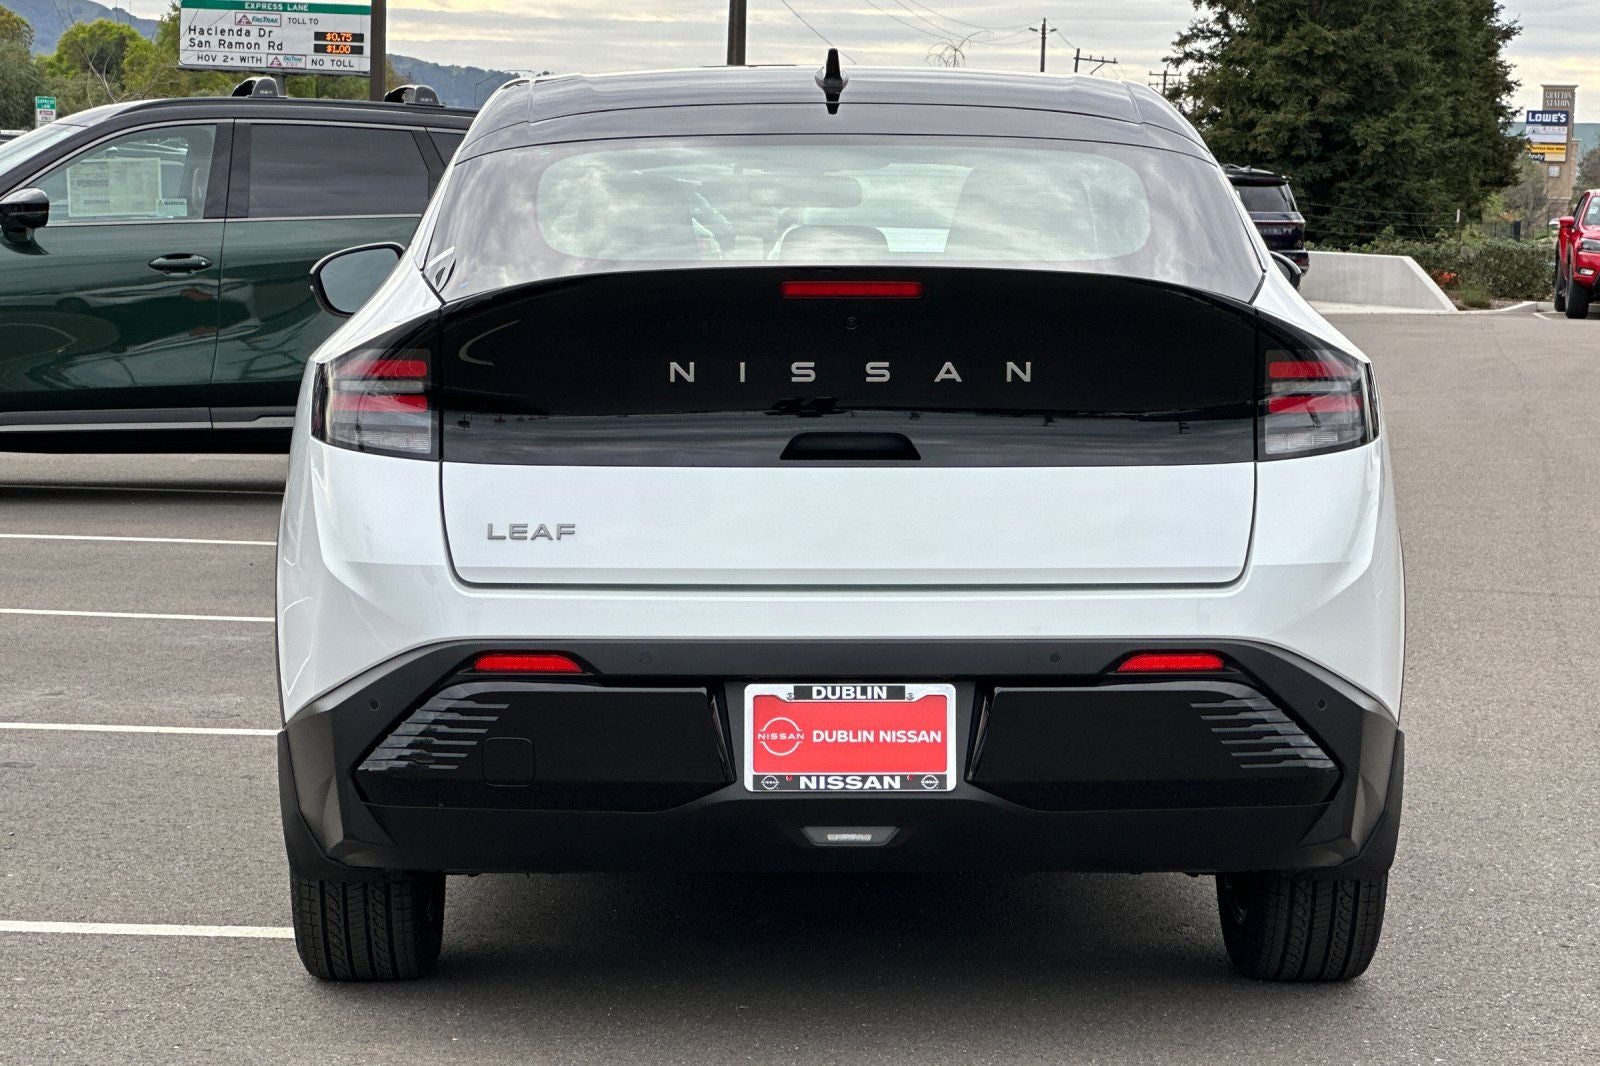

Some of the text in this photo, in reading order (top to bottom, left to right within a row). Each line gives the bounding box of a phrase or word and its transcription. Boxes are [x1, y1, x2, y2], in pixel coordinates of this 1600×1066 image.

[245, 2, 283, 10] EXPRESS
[189, 26, 273, 38] Hacienda Dr
[326, 32, 352, 42] $0.75
[189, 38, 283, 51] San Ramon Rd
[326, 45, 351, 54] $1.00
[197, 54, 217, 62] HOV
[240, 56, 262, 64] WITH
[311, 59, 324, 67] NO
[330, 59, 354, 68] TOLL
[1528, 112, 1567, 123] LOWE'S
[669, 361, 1032, 383] NISSAN
[487, 523, 576, 540] LEAF
[811, 686, 887, 700] DUBLIN
[812, 730, 942, 743] DUBLIN NISSAN
[799, 775, 901, 790] NISSAN
